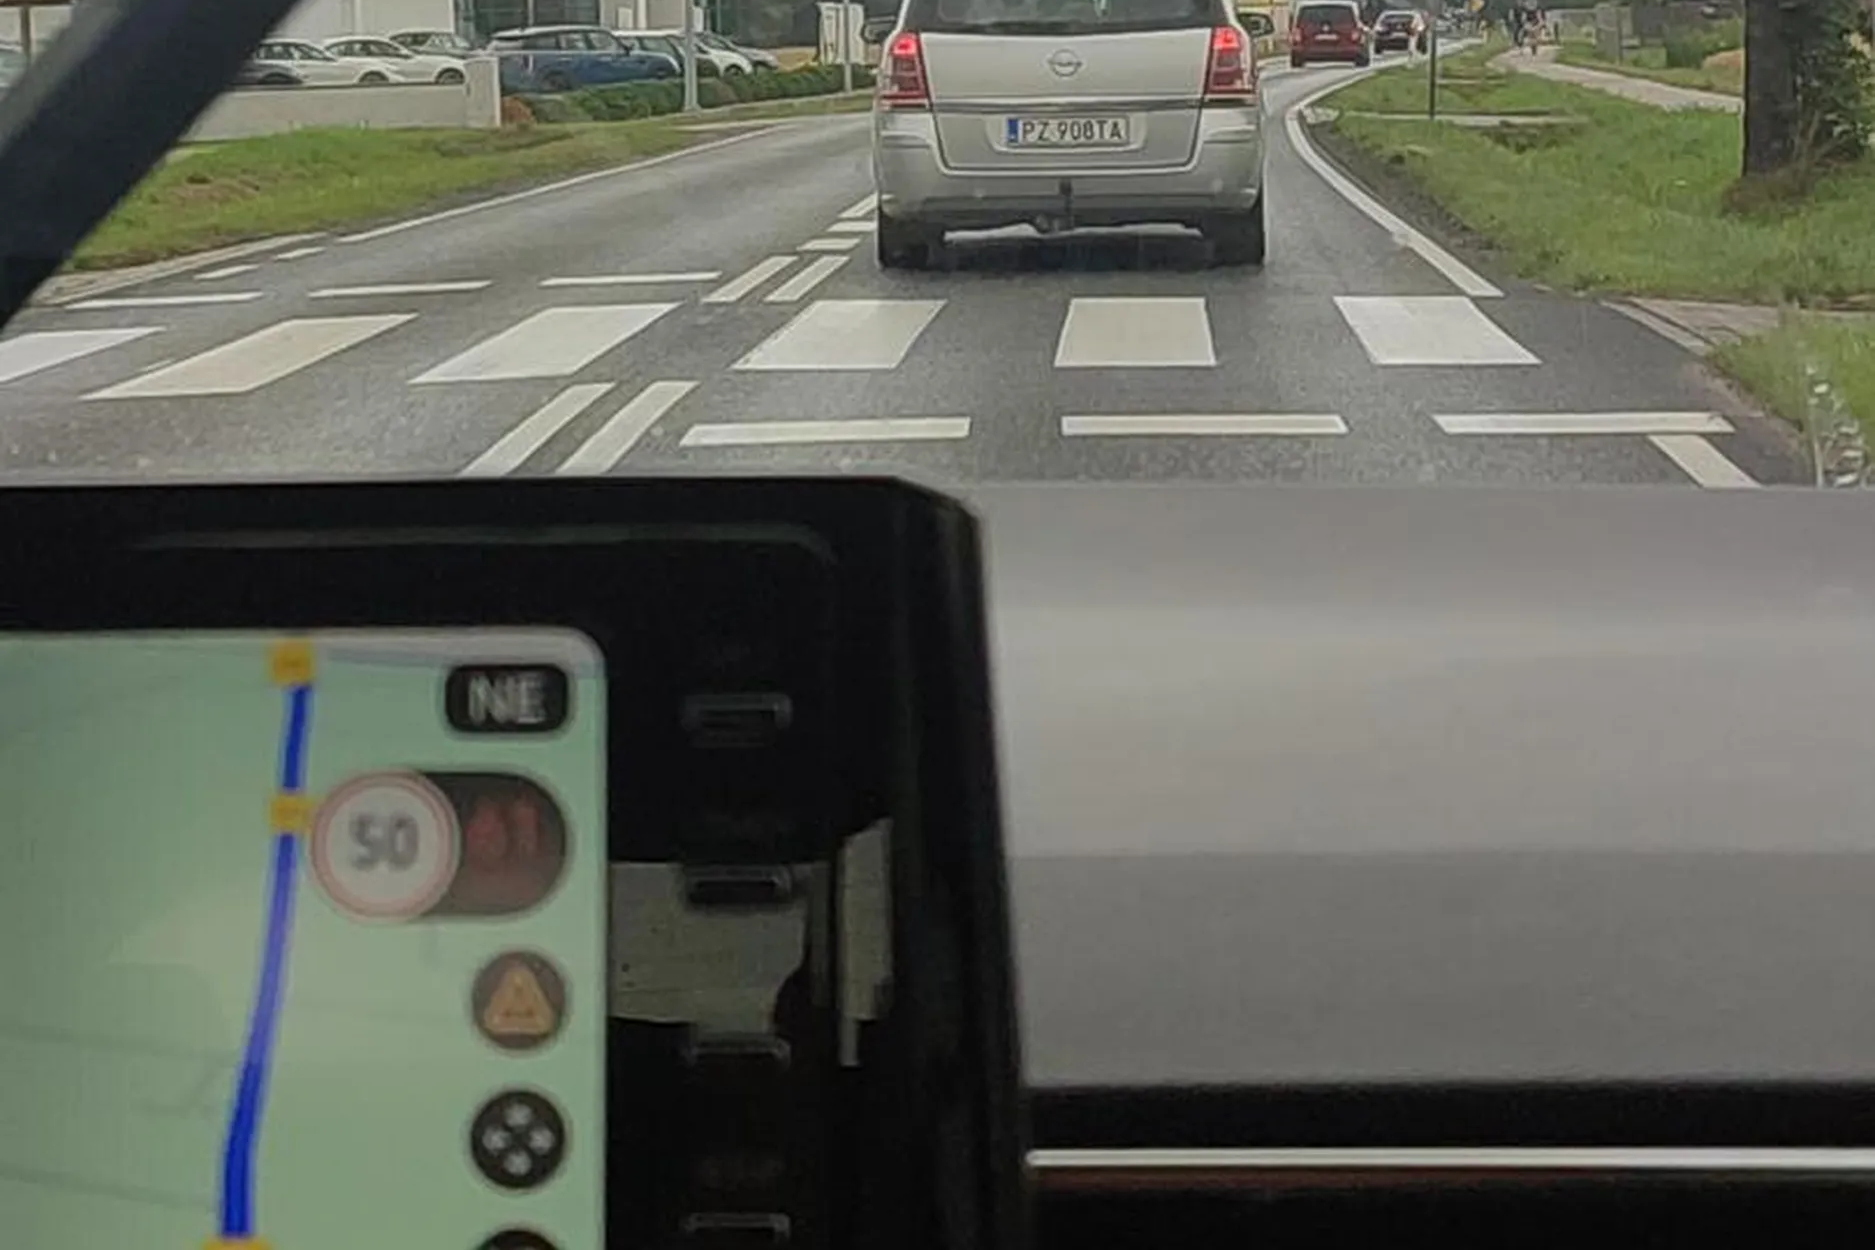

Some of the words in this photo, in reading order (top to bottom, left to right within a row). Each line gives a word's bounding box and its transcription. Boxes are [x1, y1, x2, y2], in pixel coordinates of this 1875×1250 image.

[1022, 120, 1049, 141] PZ
[1057, 119, 1122, 141] 908TA
[468, 672, 547, 724] NE
[351, 812, 420, 872] 50
